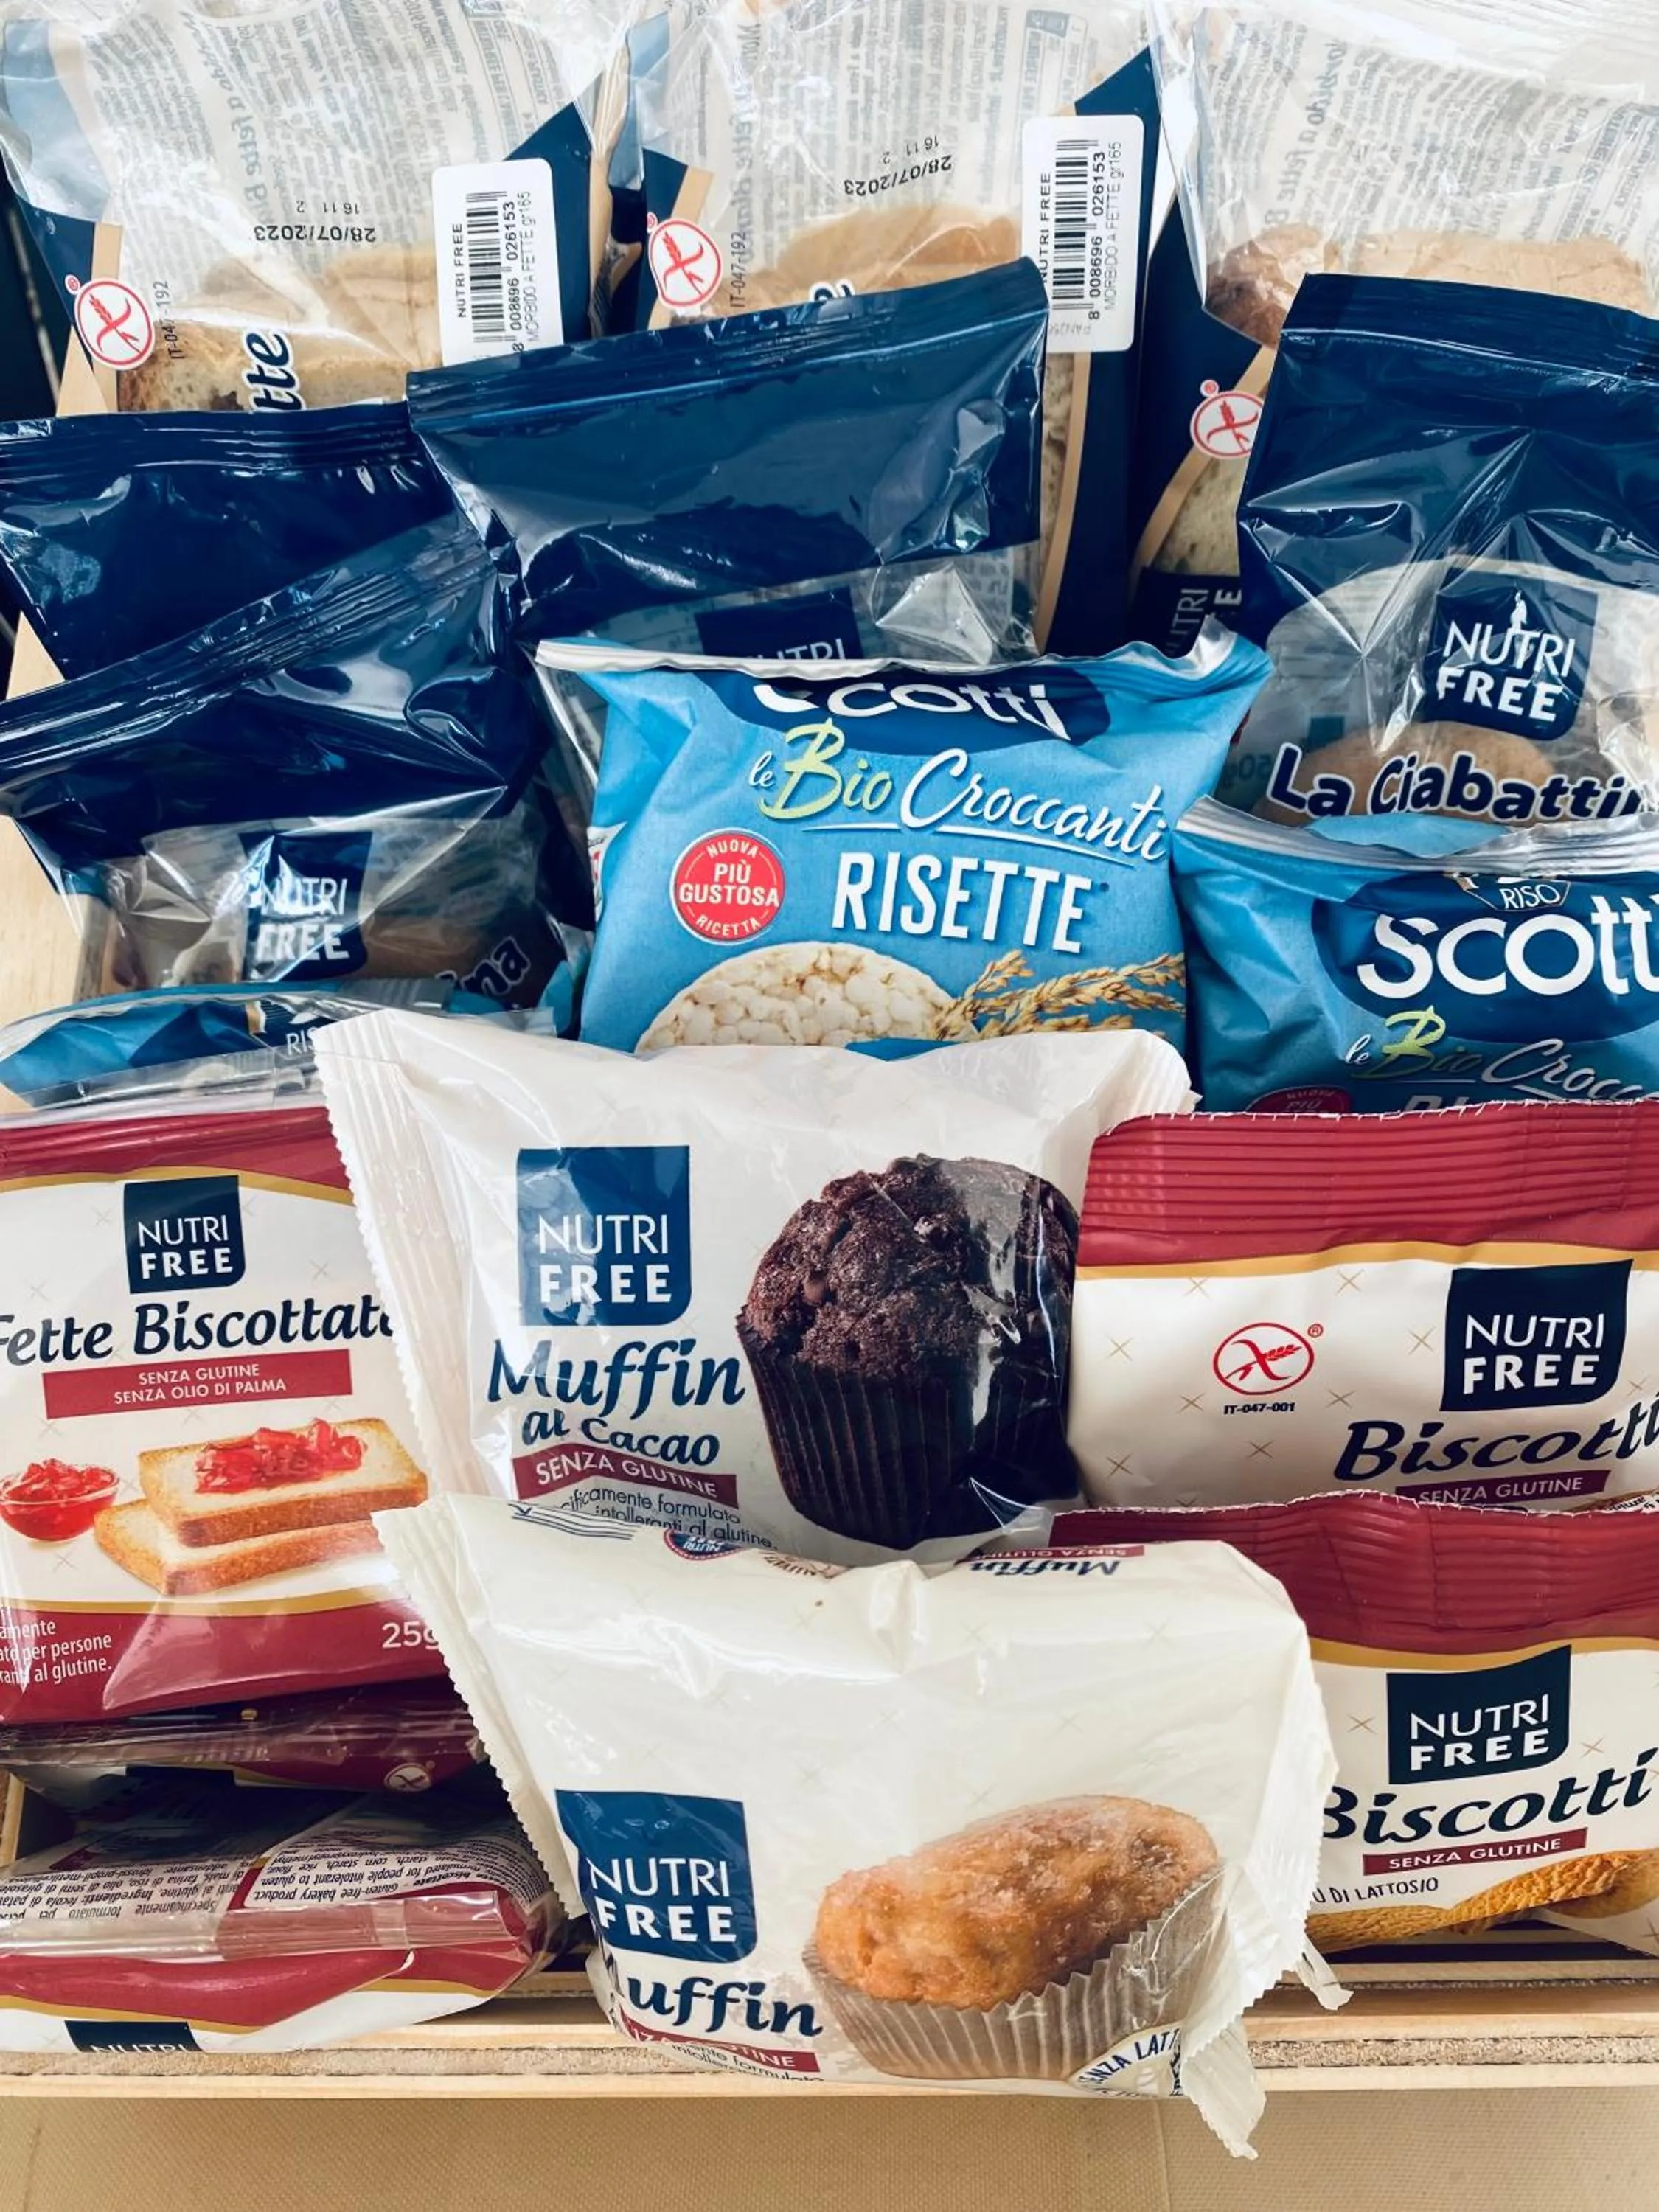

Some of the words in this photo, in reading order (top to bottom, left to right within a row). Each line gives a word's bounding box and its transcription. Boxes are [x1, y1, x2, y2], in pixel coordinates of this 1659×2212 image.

[844, 154, 953, 197] 28/07/2023
[1093, 151, 1106, 217] 026153
[1040, 172, 1051, 223] FREE
[1106, 183, 1121, 230] FETTE
[253, 224, 377, 243] 28/07/2023
[452, 223, 464, 267] FREE
[503, 201, 518, 261] 026153
[729, 231, 747, 309] IT-047-192
[1037, 228, 1051, 285] NUTRI
[1090, 235, 1103, 298] 008696
[455, 272, 466, 318] NUTRI
[508, 277, 522, 331] 008696
[1088, 310, 1100, 320] 8
[1443, 619, 1576, 678] NUTRI
[1437, 665, 1565, 722] FREE
[748, 751, 774, 787] le
[758, 717, 894, 818] Bio
[1267, 742, 1355, 819] La
[900, 748, 1169, 861] Croccanti
[706, 839, 760, 859] NUOVA
[713, 859, 751, 884] PIÙ
[261, 877, 347, 916] NUTRI
[678, 883, 779, 908] GUSTOSA
[832, 851, 1093, 954] RISETTE
[1499, 883, 1561, 911] RISO
[255, 922, 350, 961] FREE
[695, 914, 761, 936] RICETTA
[1345, 1034, 1371, 1065] le
[1350, 1004, 1484, 1079] Bio
[137, 1214, 229, 1248] NUTRI
[538, 1214, 668, 1254] NUTRI
[140, 1247, 234, 1280] FREE
[539, 1264, 672, 1304] FREE
[133, 1294, 394, 1356] Biscottat
[1467, 1313, 1605, 1349] NUTRI
[138, 1369, 190, 1386] SENZA
[195, 1362, 260, 1381] GLUTINE
[487, 1338, 746, 1421] Muffin
[1464, 1354, 1600, 1394] FREE
[114, 1388, 166, 1405] SENZA
[171, 1384, 209, 1400] OLIO
[215, 1382, 232, 1395] DI
[235, 1377, 287, 1394] PALMA
[1223, 1402, 1295, 1415] IT-047-001
[521, 1408, 571, 1446] al
[580, 1417, 721, 1466] Cacao
[535, 1450, 615, 1486] SENZA
[622, 1460, 719, 1498] GLUTINE
[1420, 1486, 1487, 1506] SENZA
[1496, 1477, 1583, 1498] GLUTINE
[658, 1493, 741, 1525] formulato
[689, 1520, 706, 1538] al
[969, 1560, 1120, 1576] Muffin
[22, 1644, 46, 1666] per
[52, 1634, 112, 1662] persone
[35, 1662, 48, 1683] al
[52, 1655, 112, 1685] glutine.
[1410, 1693, 1549, 1740] NUTRI
[1410, 1728, 1549, 1771] FREE
[299, 1863, 318, 1871] rice
[365, 1858, 388, 1866] corn
[1388, 1850, 1462, 1870] SENZA
[1470, 1838, 1562, 1860] GLUTINE
[87, 1882, 100, 1893] di
[152, 1877, 164, 1888] di
[167, 1874, 198, 1885] farina
[299, 1874, 310, 1885] to
[313, 1872, 364, 1885] intolerant
[368, 1867, 403, 1883] people
[406, 1867, 421, 1878] for
[585, 1857, 731, 1897] NUTRI
[28, 1896, 43, 1908] di
[44, 1885, 57, 1894] di
[58, 1885, 87, 1895] semi
[254, 1888, 298, 1903] product.
[300, 1888, 337, 1902] bakery
[340, 1884, 399, 1899] Gluten-free
[1329, 1886, 1350, 1904] DI
[1357, 1877, 1439, 1902] LATTOSIO
[594, 1896, 737, 1943] FREE
[626, 1976, 824, 2037] uffin
